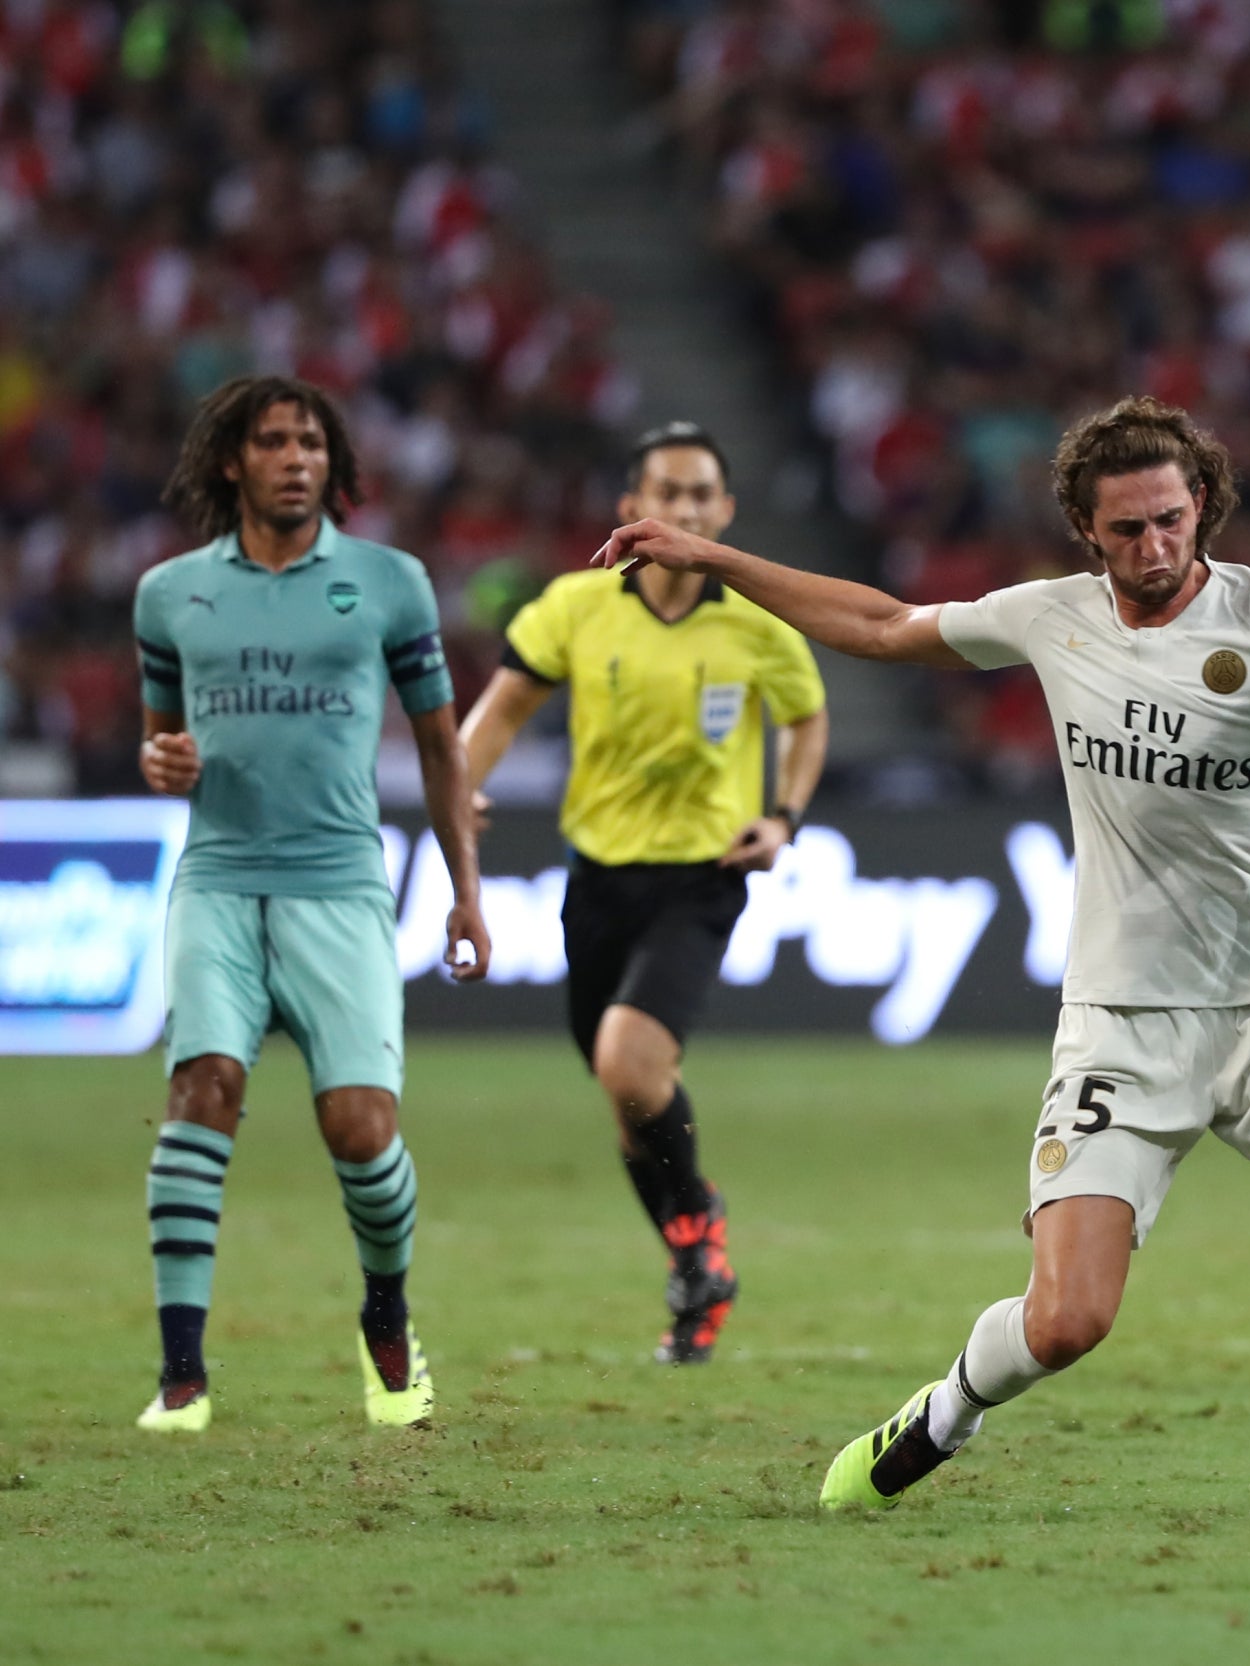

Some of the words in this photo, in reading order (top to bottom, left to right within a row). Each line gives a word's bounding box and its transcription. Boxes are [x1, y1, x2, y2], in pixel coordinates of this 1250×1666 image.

[239, 647, 294, 677] Fly
[194, 676, 354, 722] Emirates
[1124, 699, 1186, 743] Fly
